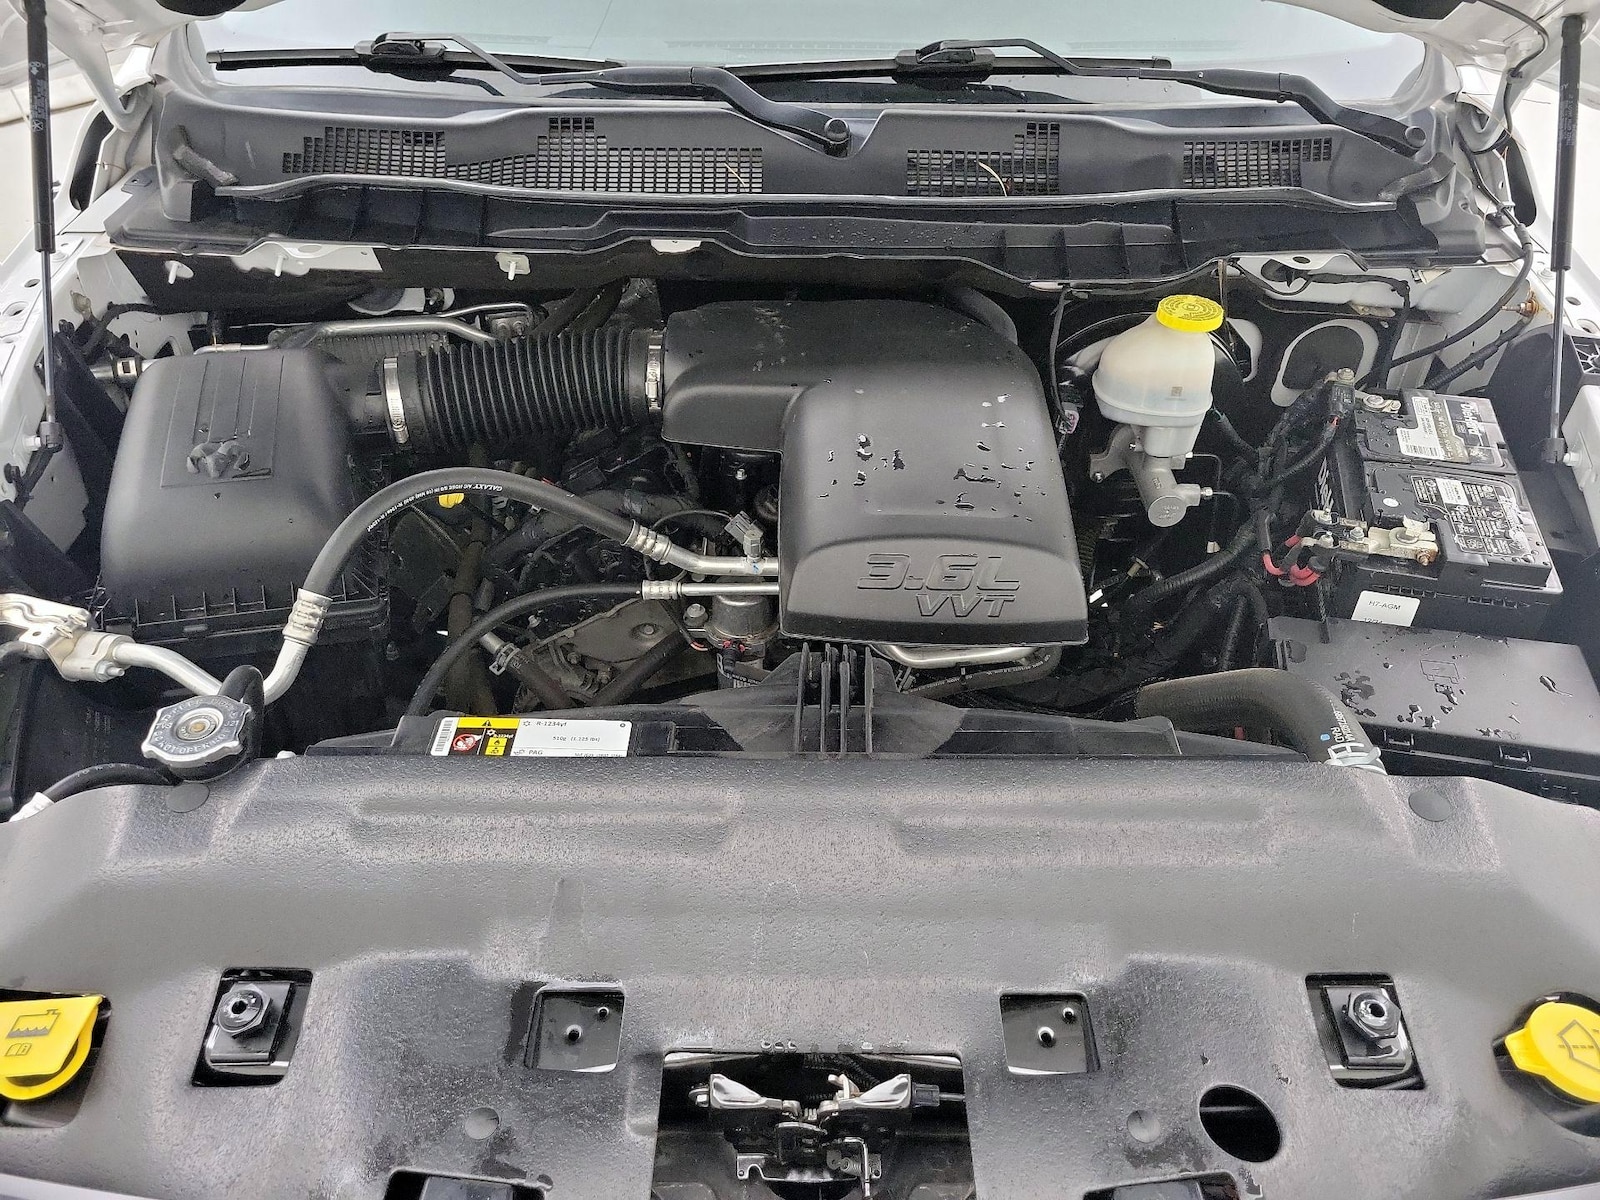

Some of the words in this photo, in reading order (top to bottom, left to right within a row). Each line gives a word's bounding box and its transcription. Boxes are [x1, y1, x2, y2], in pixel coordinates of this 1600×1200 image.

[473, 483, 502, 491] GALAXY
[857, 553, 1021, 591] 3.6L
[915, 593, 1016, 617] VVT
[1368, 601, 1401, 611] H7-AGM
[1331, 726, 1345, 743] RAD
